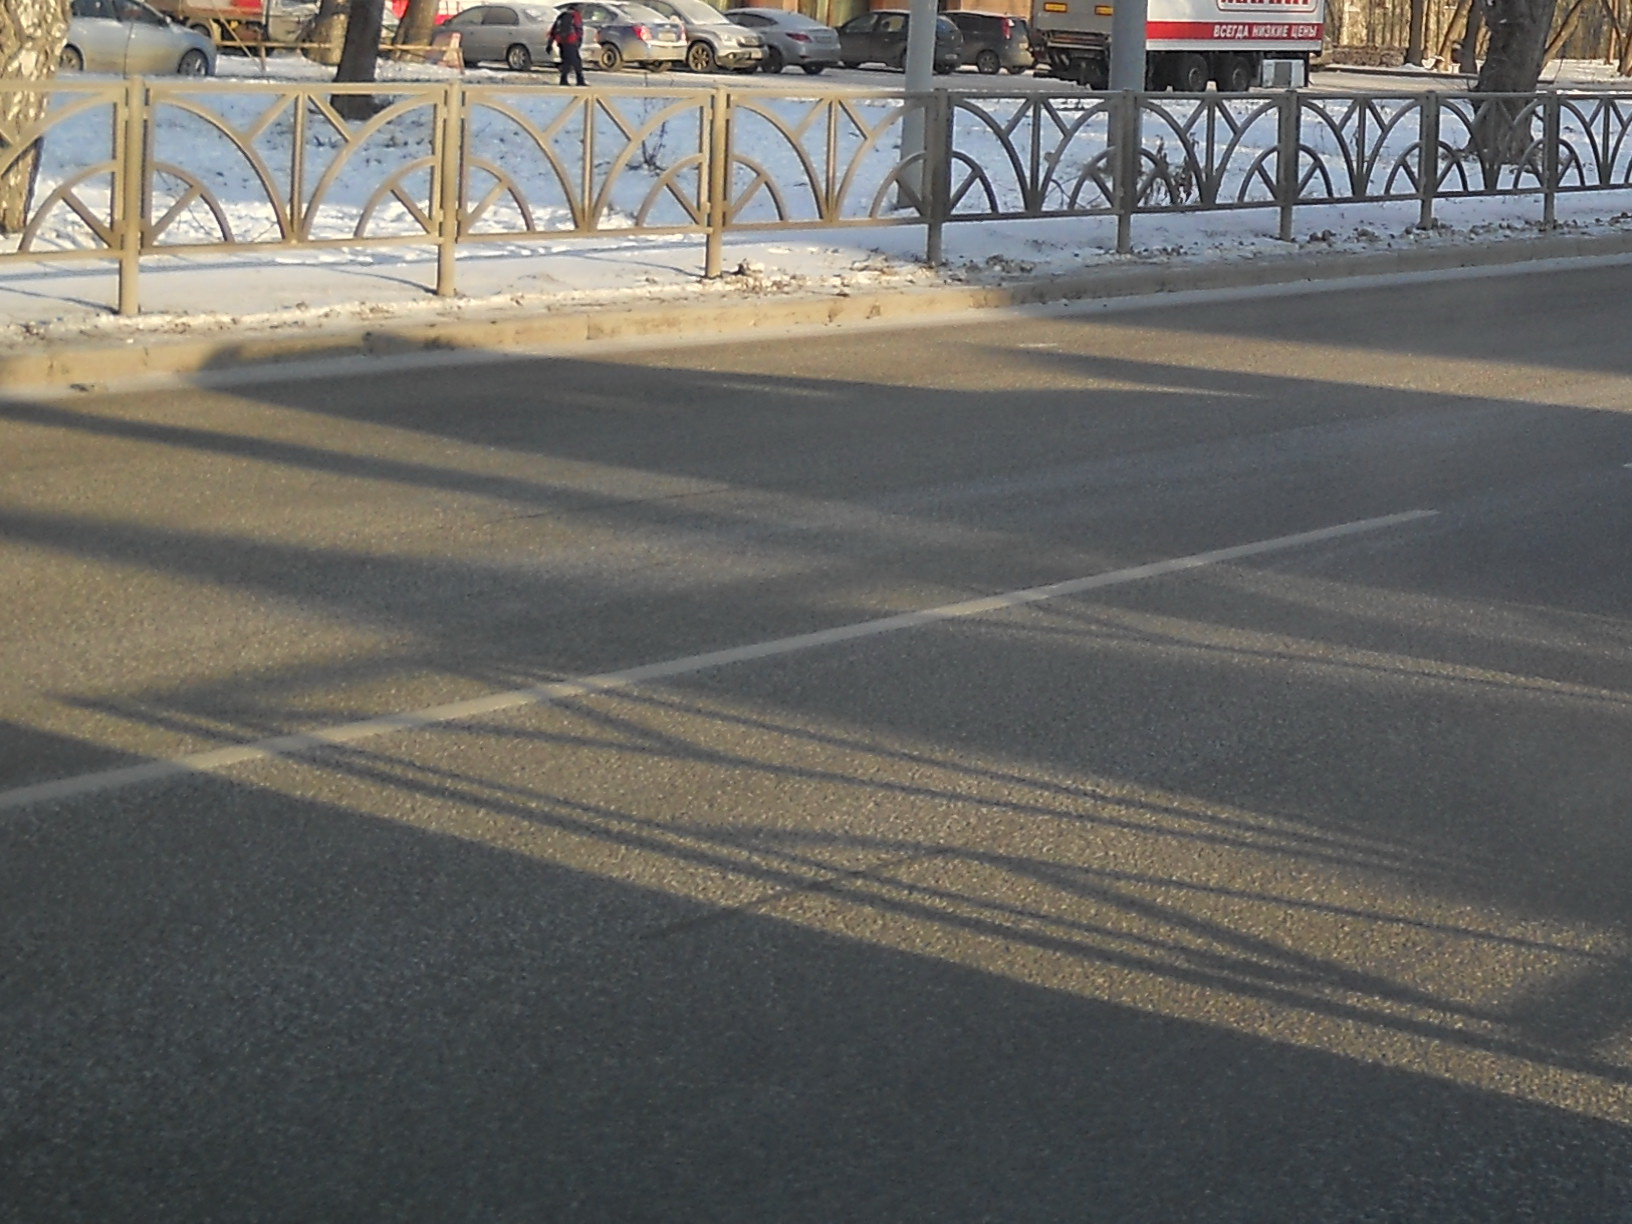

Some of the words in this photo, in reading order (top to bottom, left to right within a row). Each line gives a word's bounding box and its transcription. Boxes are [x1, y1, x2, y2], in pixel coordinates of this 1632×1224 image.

[1213, 24, 1249, 39] ВСЕГДА
[1251, 25, 1288, 37] НИЗКИЕ
[1291, 25, 1318, 39] ЦЕНЫ
